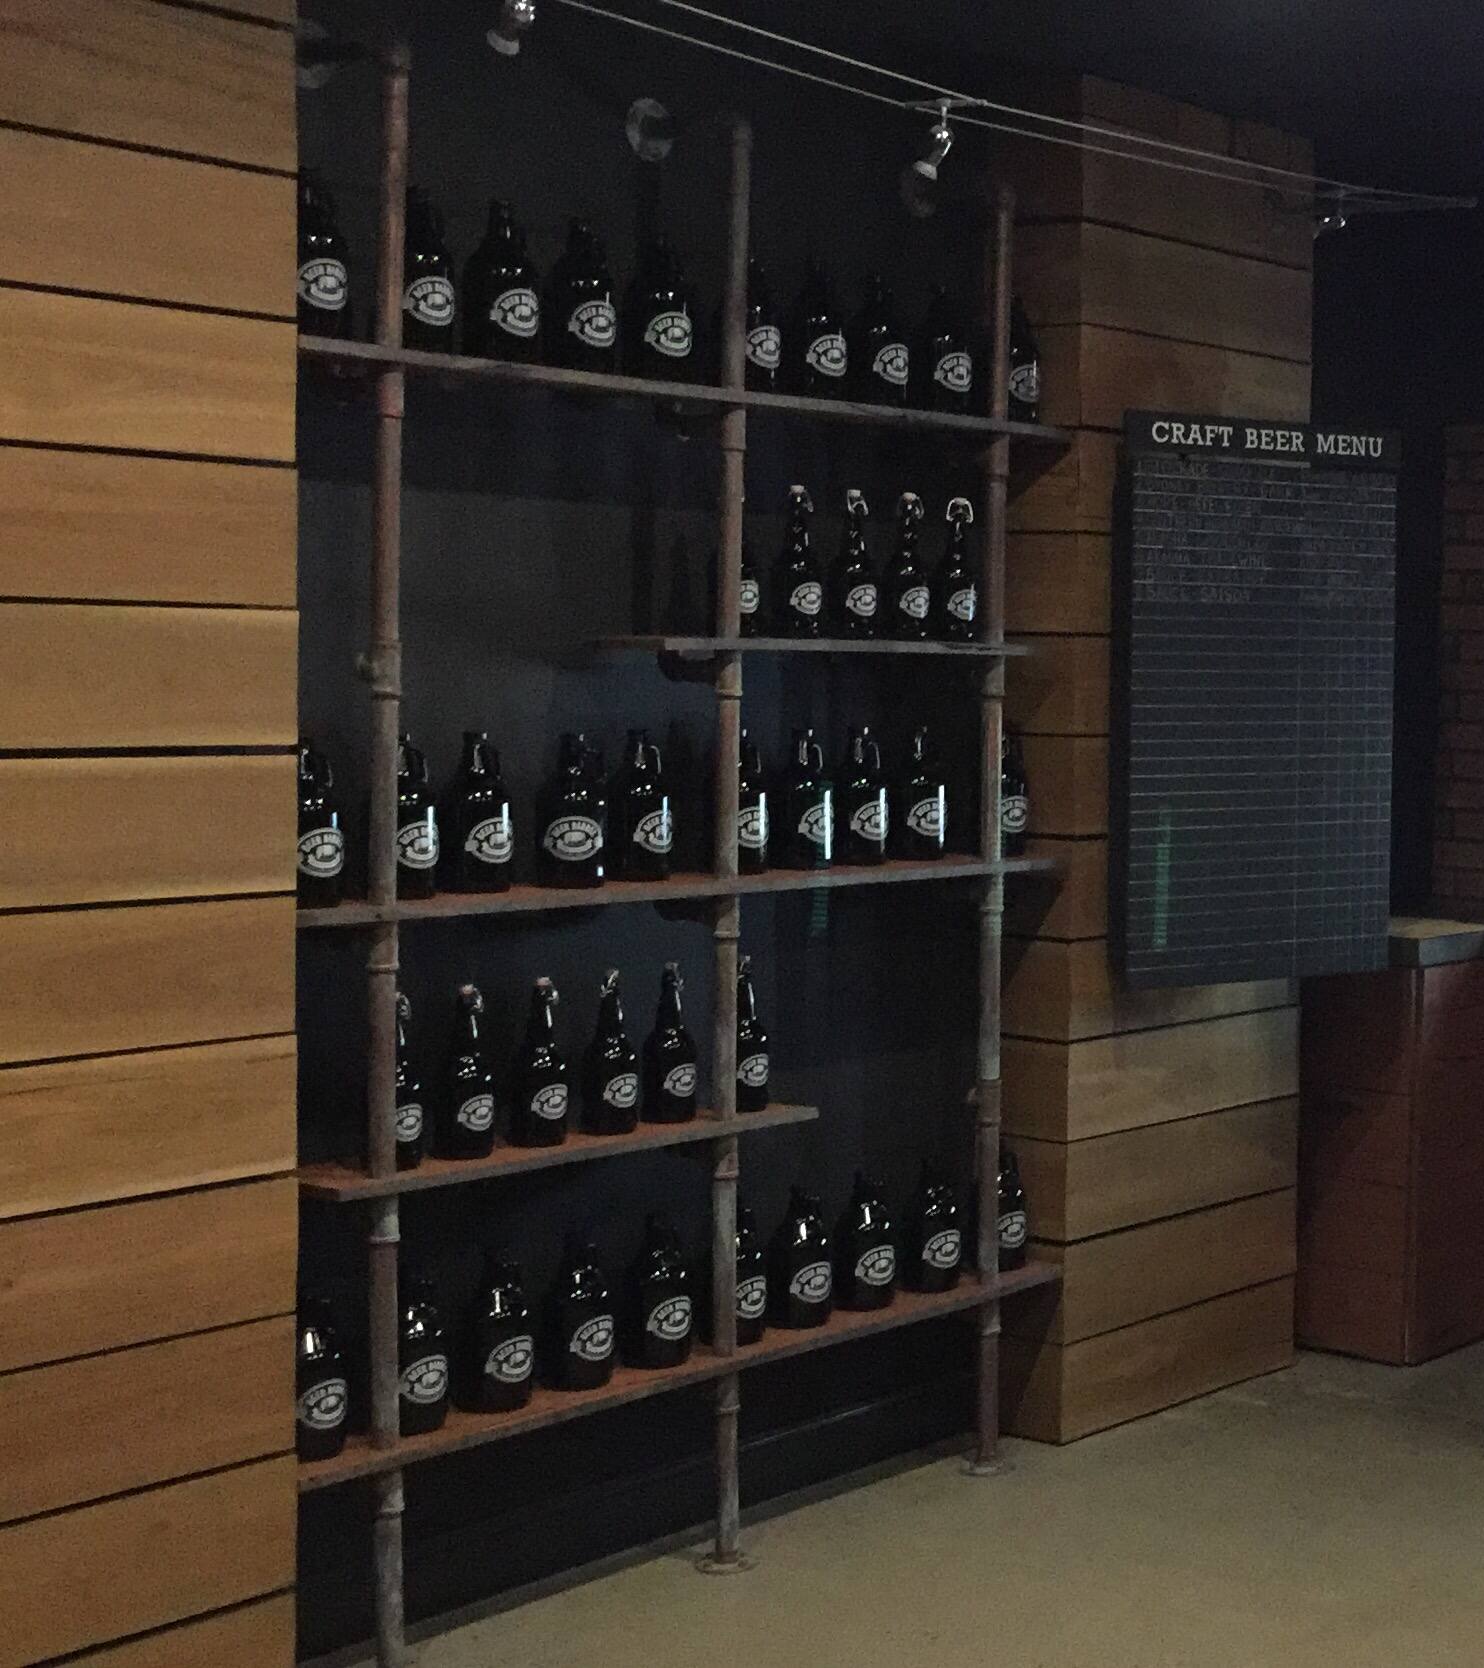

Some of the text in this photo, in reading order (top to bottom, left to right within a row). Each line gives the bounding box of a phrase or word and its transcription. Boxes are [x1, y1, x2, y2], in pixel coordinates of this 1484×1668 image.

[1152, 421, 1383, 458] CRAFT BEER MENU
